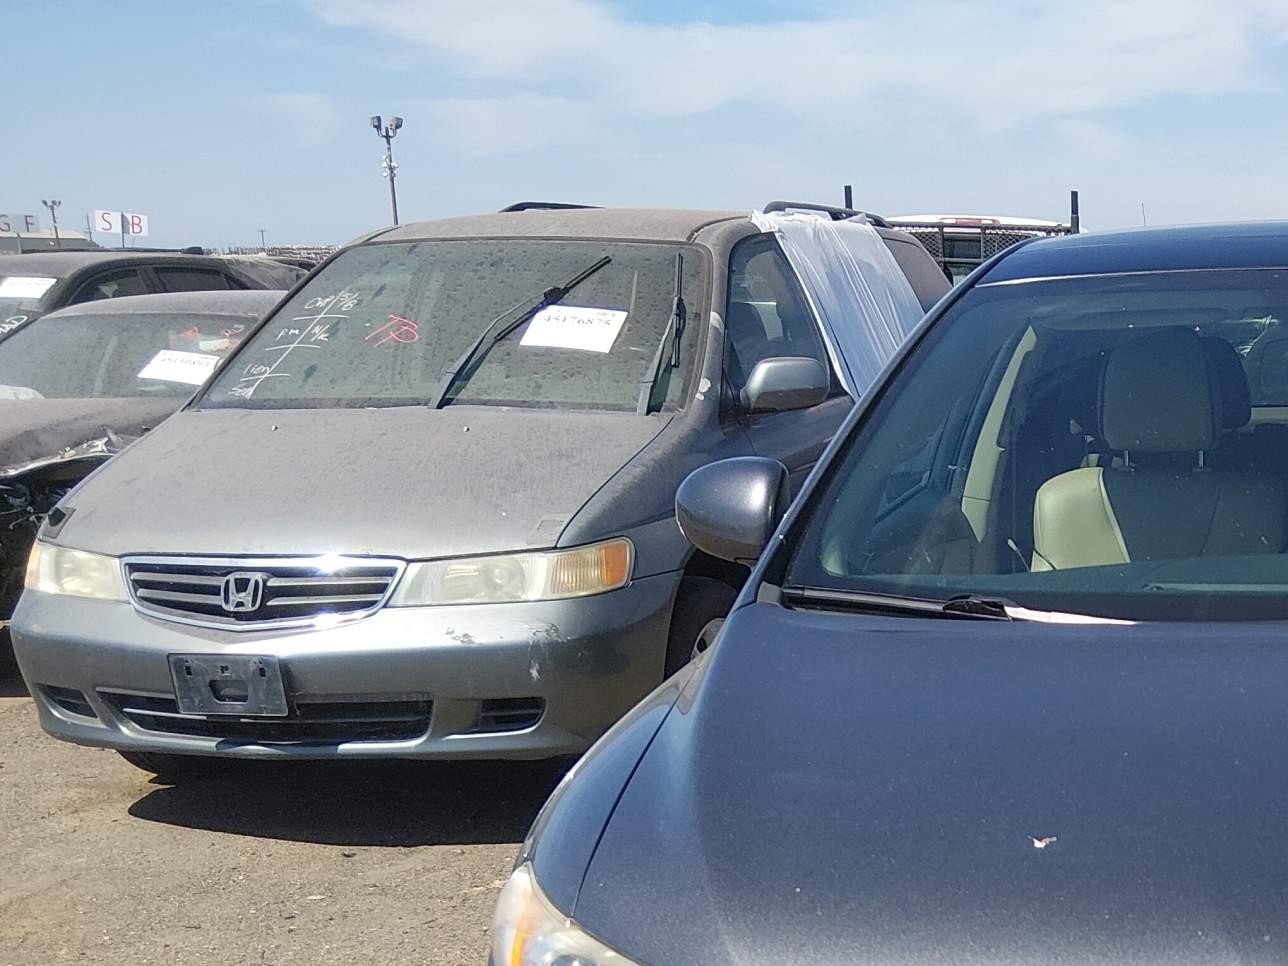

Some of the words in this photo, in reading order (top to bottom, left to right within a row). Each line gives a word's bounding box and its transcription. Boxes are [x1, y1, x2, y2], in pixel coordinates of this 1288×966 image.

[0, 214, 11, 233] G
[24, 215, 34, 233] F
[101, 212, 113, 232] S
[131, 215, 143, 235] B
